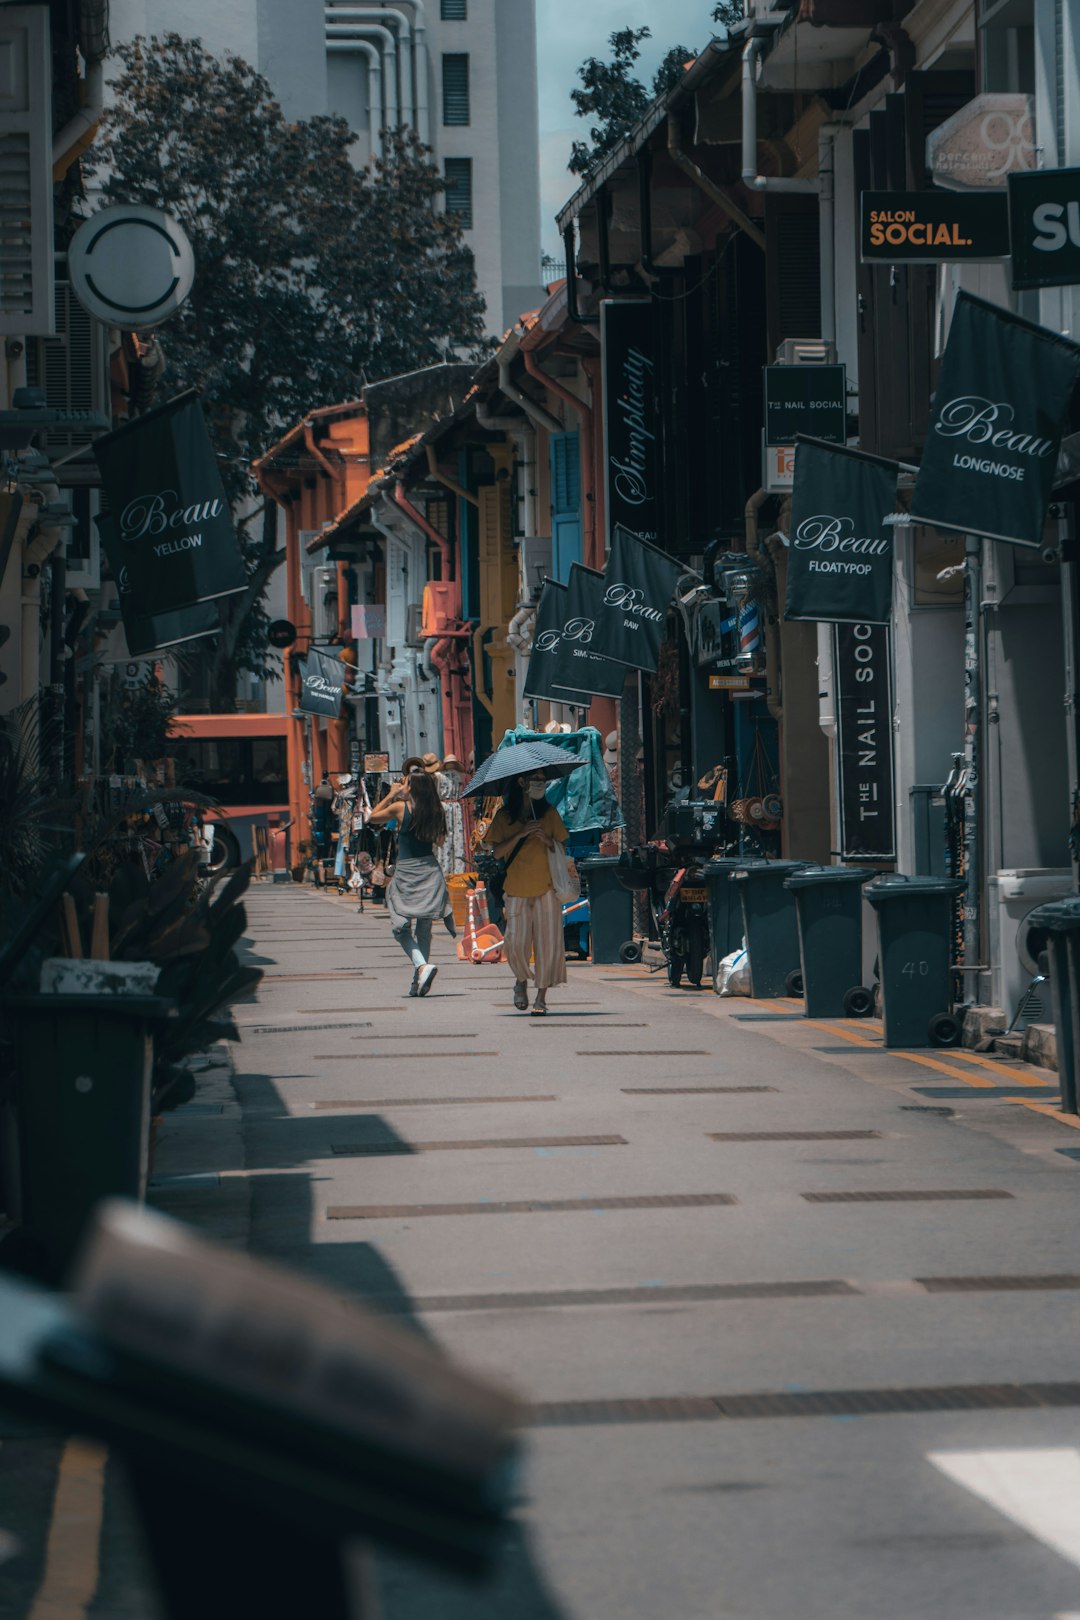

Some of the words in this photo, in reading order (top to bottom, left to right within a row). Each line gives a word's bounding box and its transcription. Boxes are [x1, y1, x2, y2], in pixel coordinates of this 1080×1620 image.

[870, 211, 915, 223] SALON
[870, 224, 972, 245] SOCIAL.
[785, 401, 806, 409] NAIL
[809, 401, 843, 409] SOCIAL
[609, 345, 656, 505] Simplicity
[934, 395, 1055, 458] Beau
[953, 453, 1025, 481] LONGNOSE
[121, 489, 223, 542] Beau
[153, 534, 202, 558] YELLOW
[794, 514, 889, 555] Beau
[809, 560, 873, 576] FLOATYPOP
[603, 583, 664, 622] Beau
[561, 617, 596, 643] B
[623, 619, 640, 631] RAW
[853, 623, 875, 683] SOC
[305, 675, 342, 694] Beau
[858, 699, 877, 767] NAIL
[858, 782, 879, 822] THE
